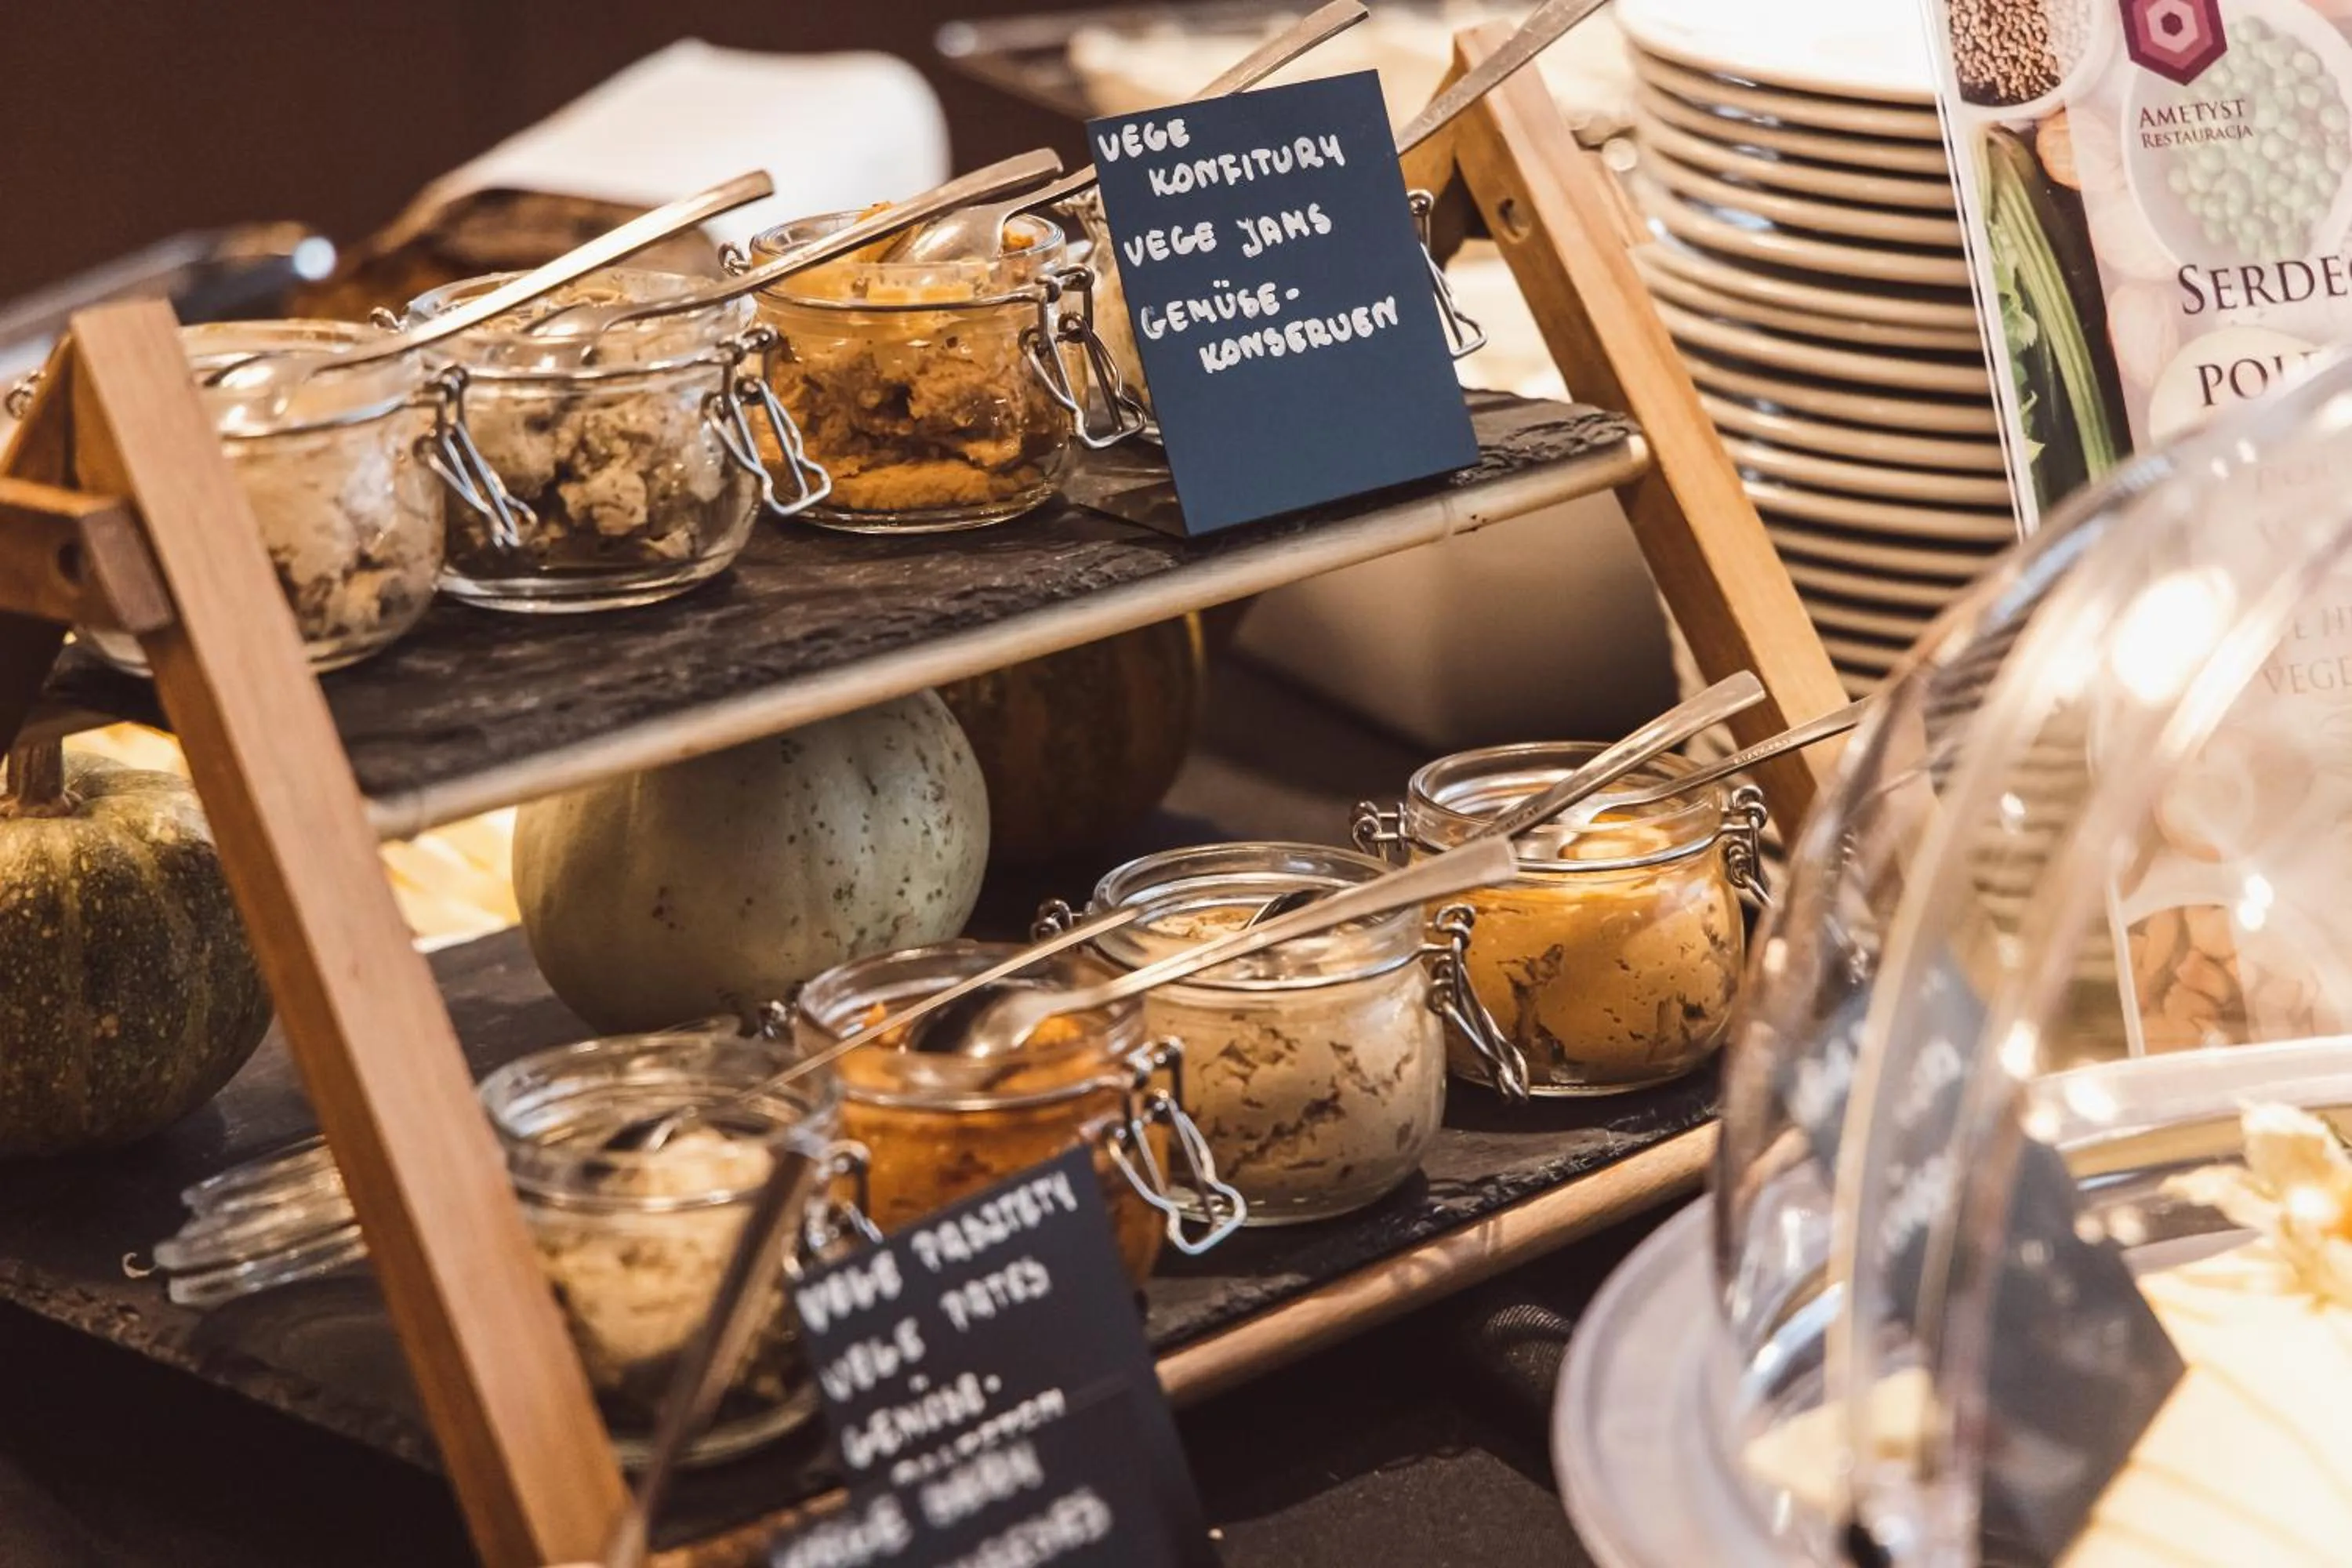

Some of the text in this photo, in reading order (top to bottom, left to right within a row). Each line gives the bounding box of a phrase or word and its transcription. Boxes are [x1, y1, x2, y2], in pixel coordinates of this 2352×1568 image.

[1098, 118, 1190, 162] VEGE
[2140, 98, 2246, 128] AMETYST
[2141, 124, 2253, 150] RESTAURACJA
[1149, 133, 1345, 197] KONFITURY
[1123, 202, 1332, 266] VEGE JAMS
[1141, 280, 1301, 339] GEMÜSE-
[2178, 254, 2352, 315] SERDE
